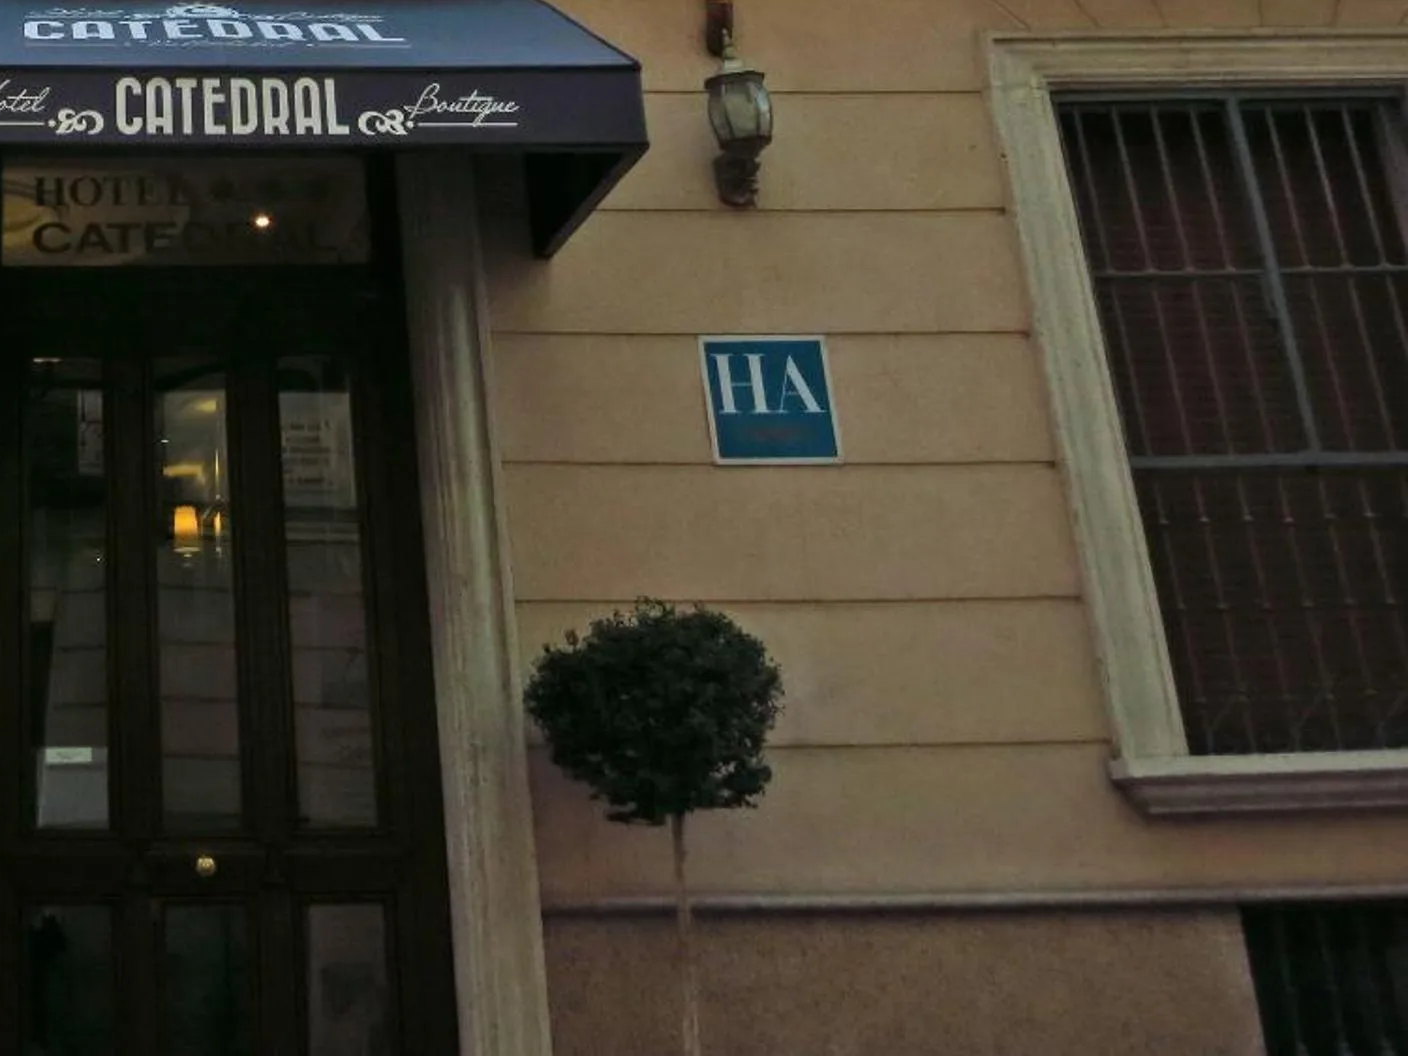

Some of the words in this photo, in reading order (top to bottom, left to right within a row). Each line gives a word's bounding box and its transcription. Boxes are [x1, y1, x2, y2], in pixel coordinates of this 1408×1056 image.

[24, 19, 405, 41] CATEDRAL
[116, 77, 350, 135] CATEDRAL
[403, 82, 520, 127] Boutique
[710, 353, 827, 413] HA
